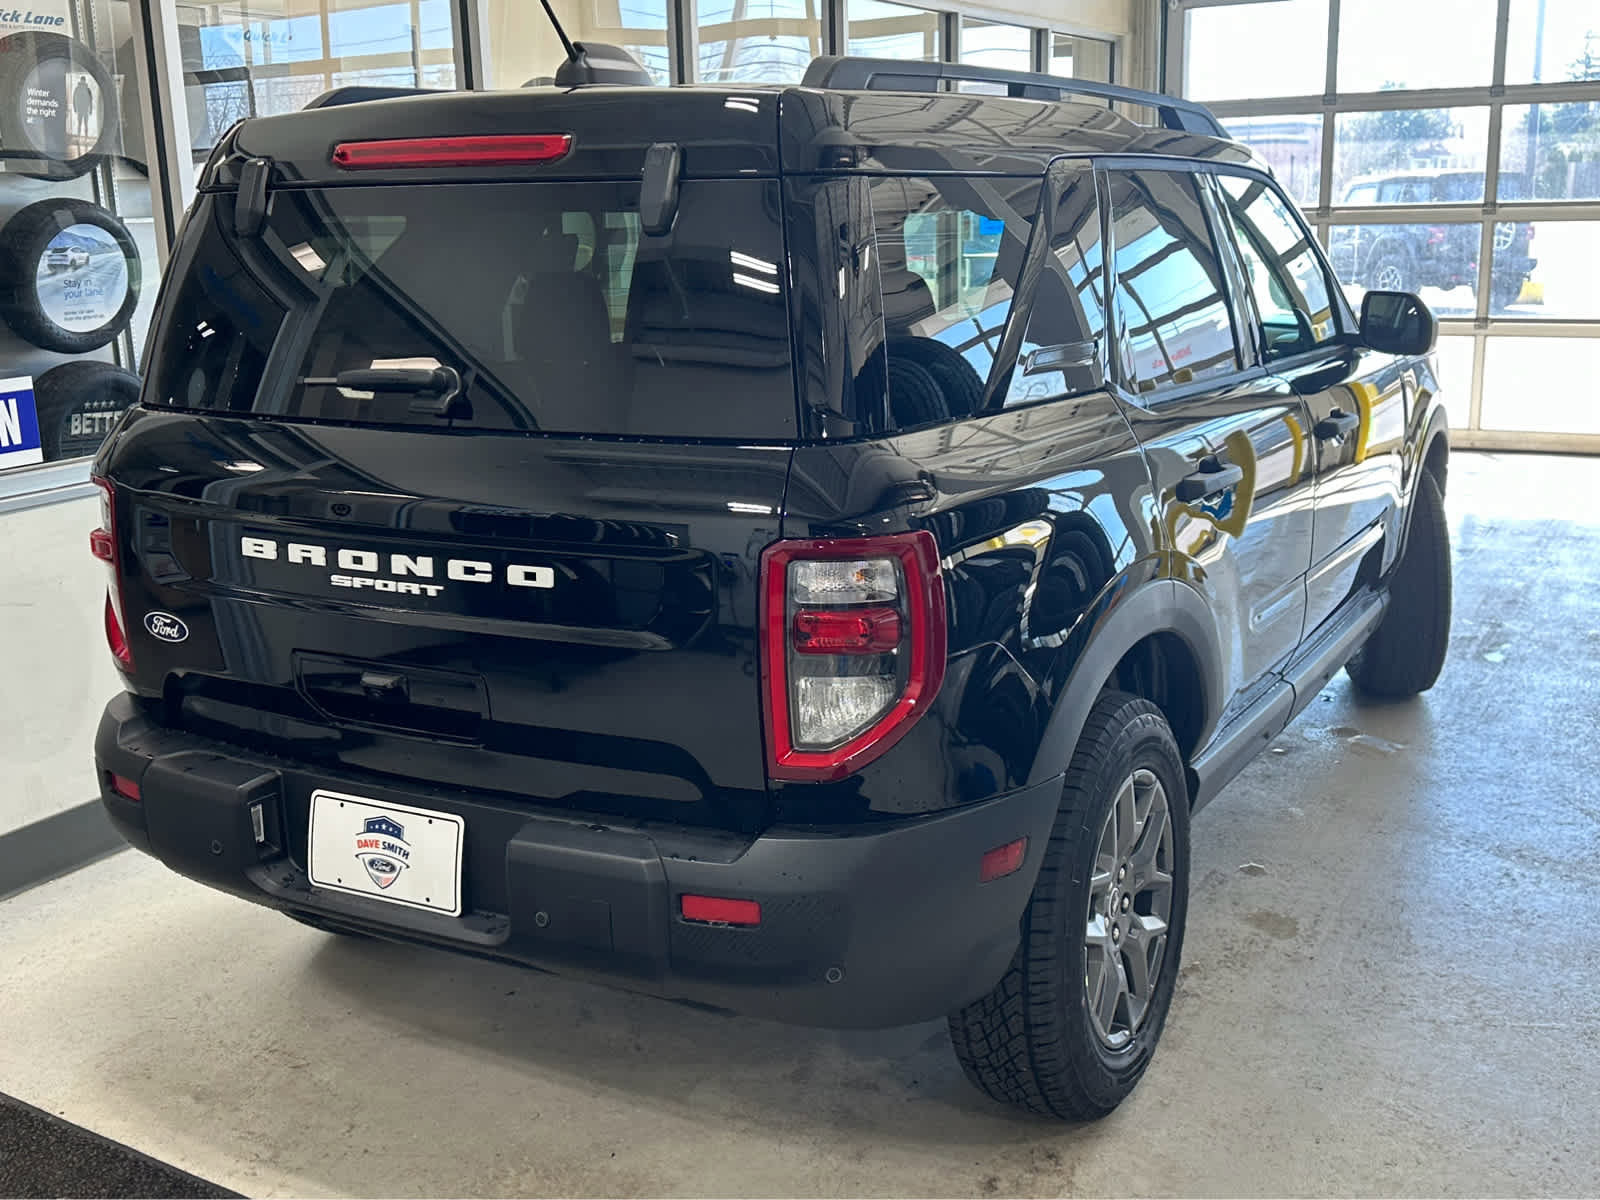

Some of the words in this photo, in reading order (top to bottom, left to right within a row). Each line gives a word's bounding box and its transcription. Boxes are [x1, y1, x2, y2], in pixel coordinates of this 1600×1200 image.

[24, 11, 65, 26] Lane
[27, 87, 50, 97] Winter
[26, 97, 59, 108] demands
[26, 106, 39, 115] the
[39, 108, 57, 118] right
[63, 279, 81, 289] Stay
[63, 290, 82, 301] your
[241, 536, 555, 589] BRONCO
[330, 574, 444, 597] SPORT
[150, 615, 181, 639] Ford
[356, 838, 381, 849] DAVE
[381, 841, 410, 860] SMITH
